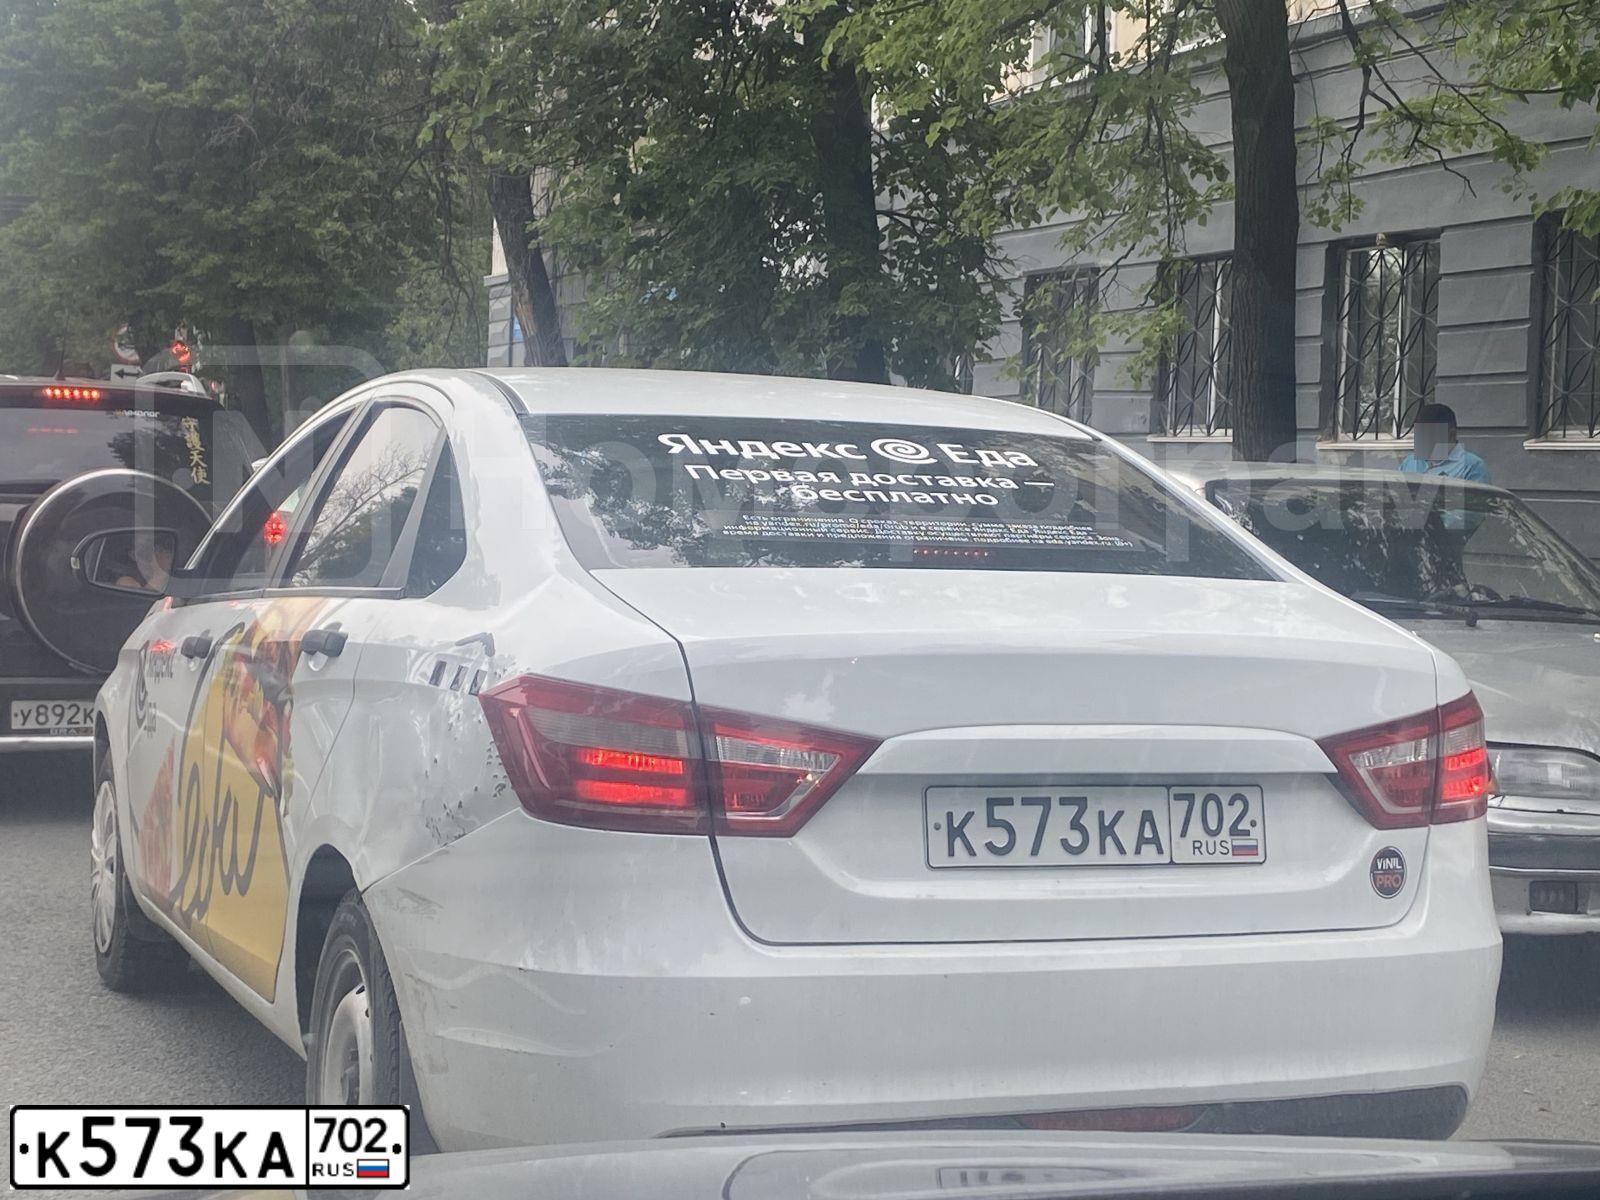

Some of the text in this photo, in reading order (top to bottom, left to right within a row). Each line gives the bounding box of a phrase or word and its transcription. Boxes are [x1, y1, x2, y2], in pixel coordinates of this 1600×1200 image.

[657, 433, 1039, 469] Яндекс Еда
[684, 464, 841, 485] Первая
[851, 472, 1018, 490] доставка
[790, 484, 999, 507] бесплатно
[20, 703, 94, 726] У892К
[946, 793, 1251, 857] К573КА 702
[1193, 840, 1230, 856] RUS
[1376, 874, 1402, 888] PRO
